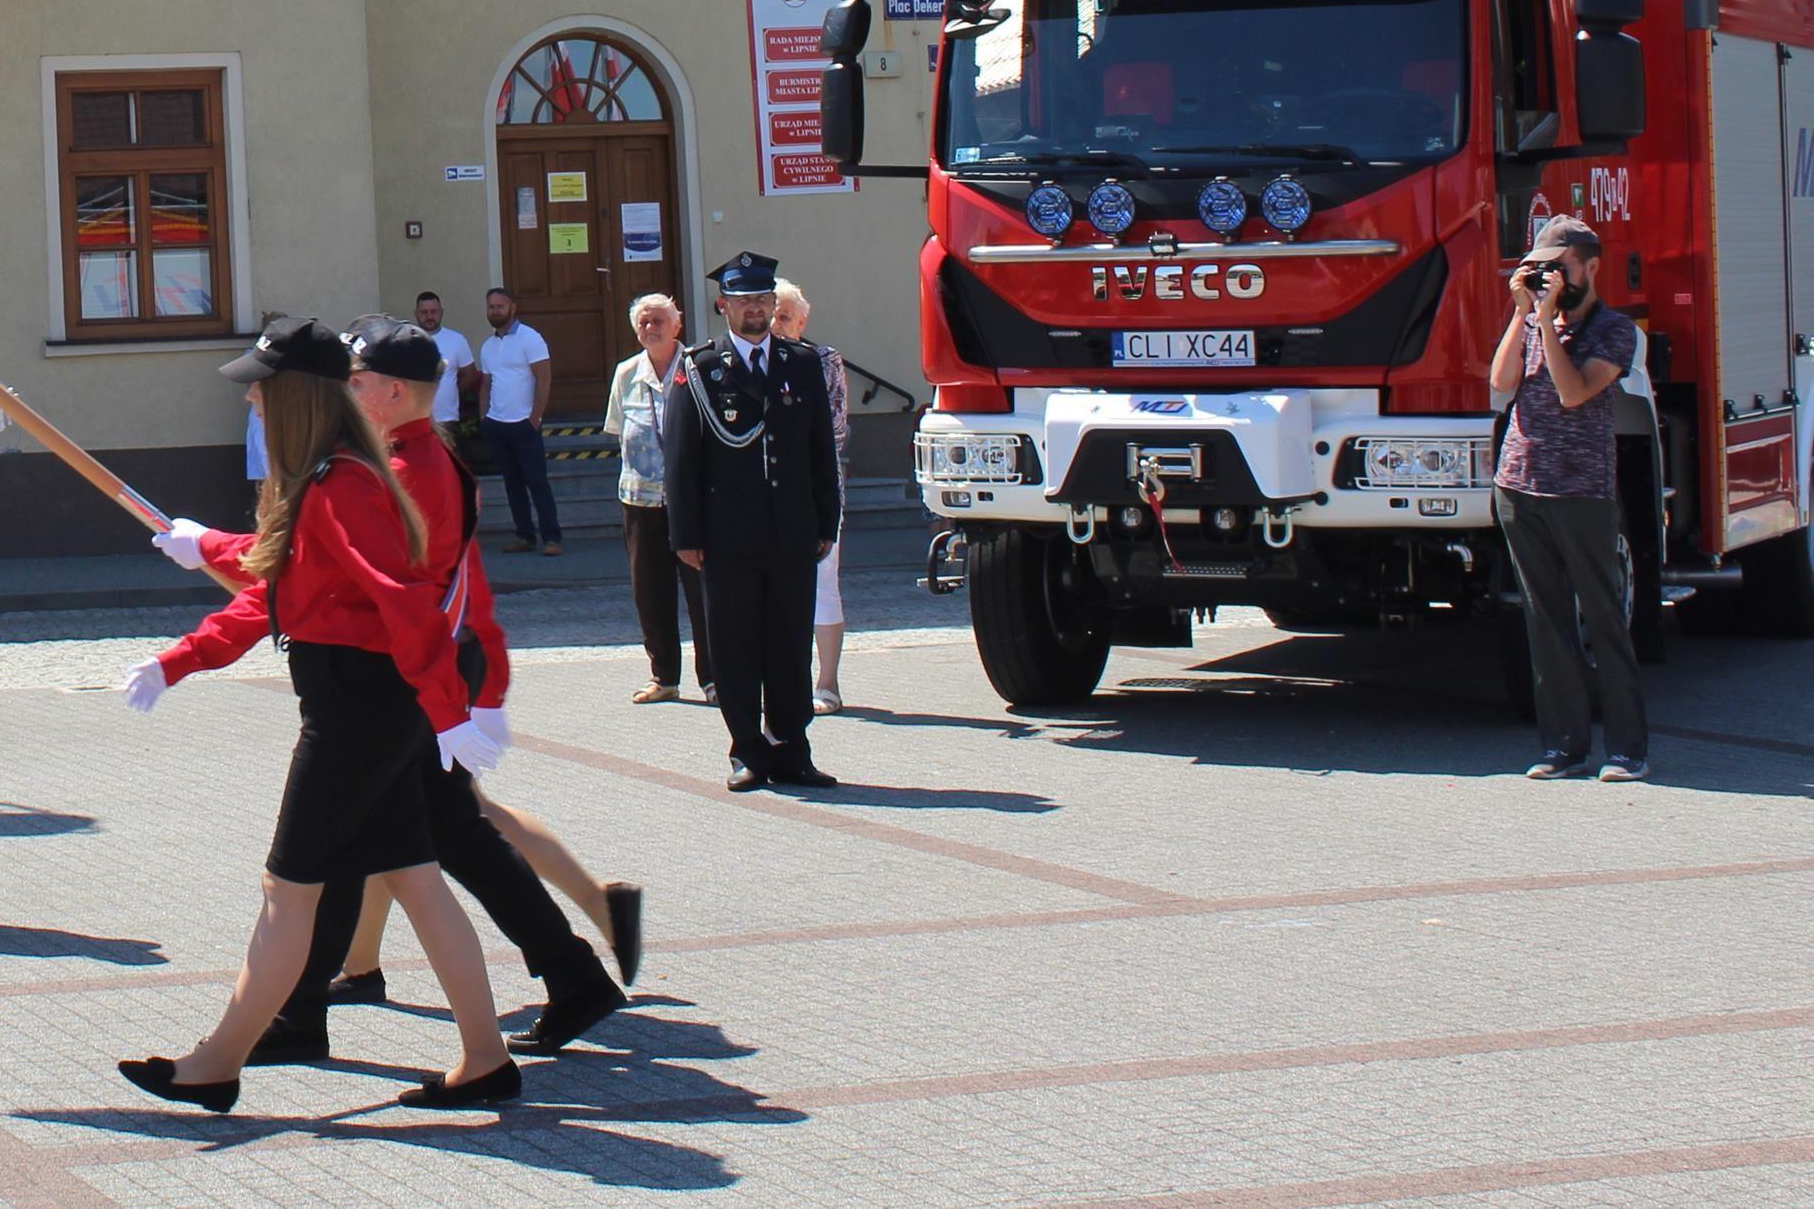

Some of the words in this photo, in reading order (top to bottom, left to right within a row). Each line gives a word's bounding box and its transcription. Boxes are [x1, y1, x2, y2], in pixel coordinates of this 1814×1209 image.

[770, 37, 793, 45] RADA
[790, 45, 818, 53] LIPNIE
[880, 57, 886, 71] 8
[775, 87, 806, 95] MIASTA
[783, 166, 834, 174] CYWILNEGO
[1091, 264, 1265, 300] IVECO
[1129, 335, 1171, 359] CLI
[1186, 334, 1248, 358] XC44
